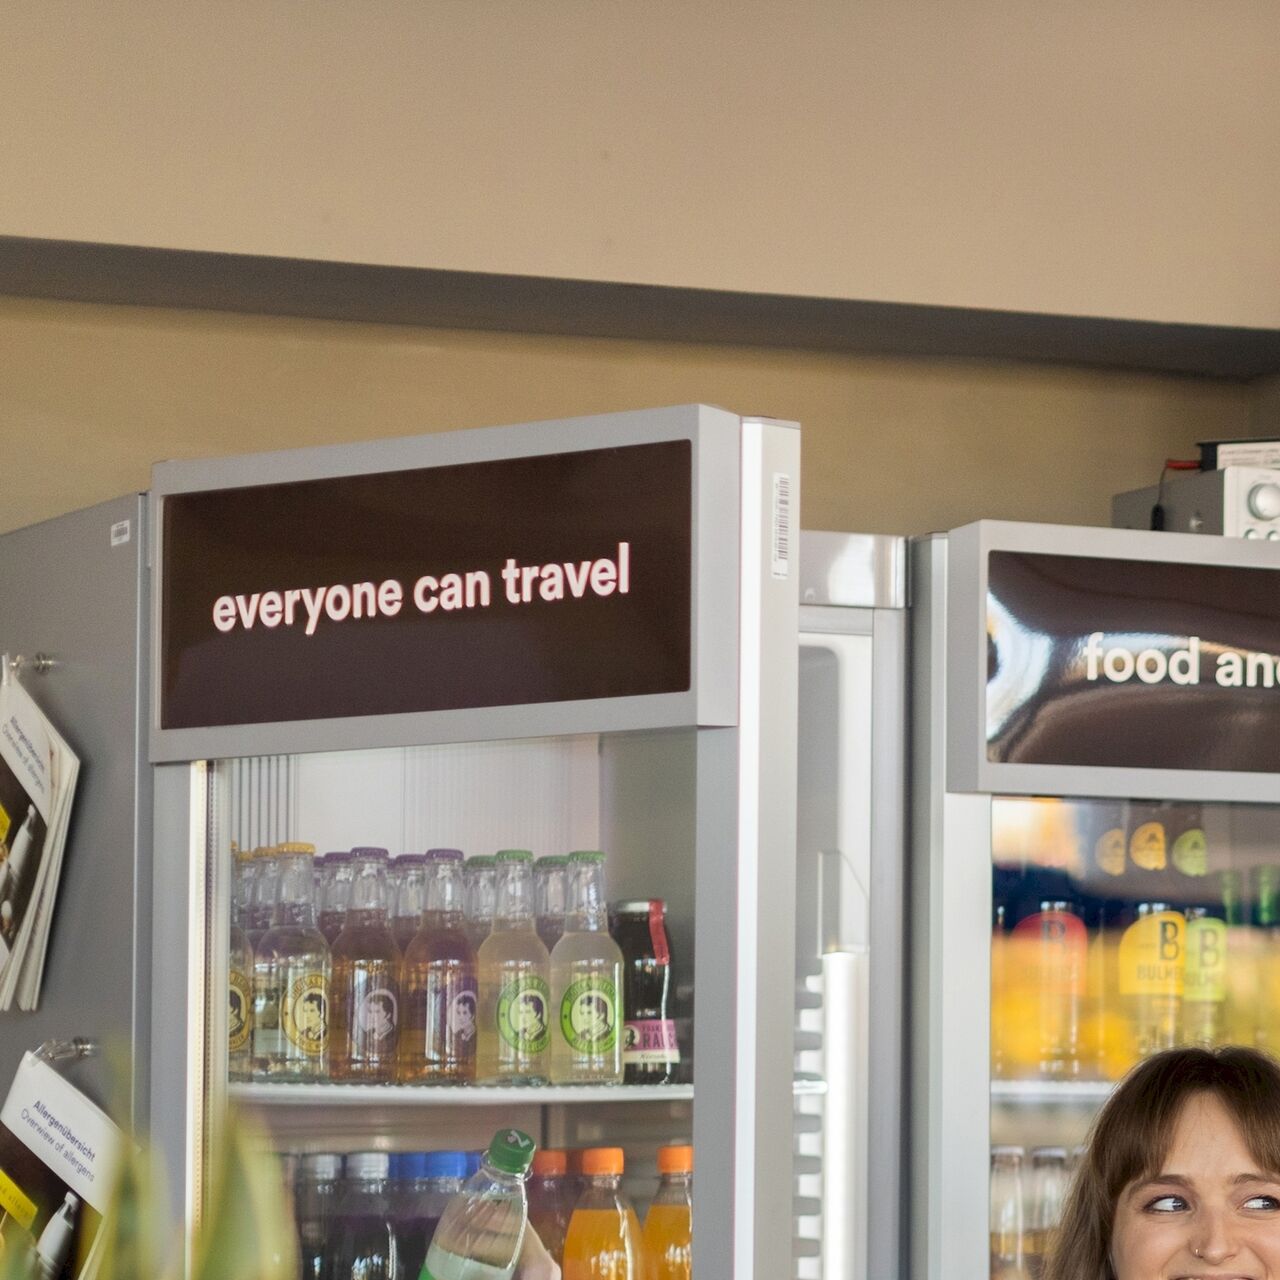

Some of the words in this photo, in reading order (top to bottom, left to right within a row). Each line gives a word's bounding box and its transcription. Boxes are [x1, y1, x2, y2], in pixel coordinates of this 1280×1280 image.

[213, 581, 403, 635] everyone
[413, 566, 491, 614] can
[502, 541, 630, 603] travel
[1083, 632, 1201, 684] food
[1159, 920, 1180, 961] B
[32, 1099, 97, 1163] Allergenübersicht
[54, 1142, 65, 1153] of
